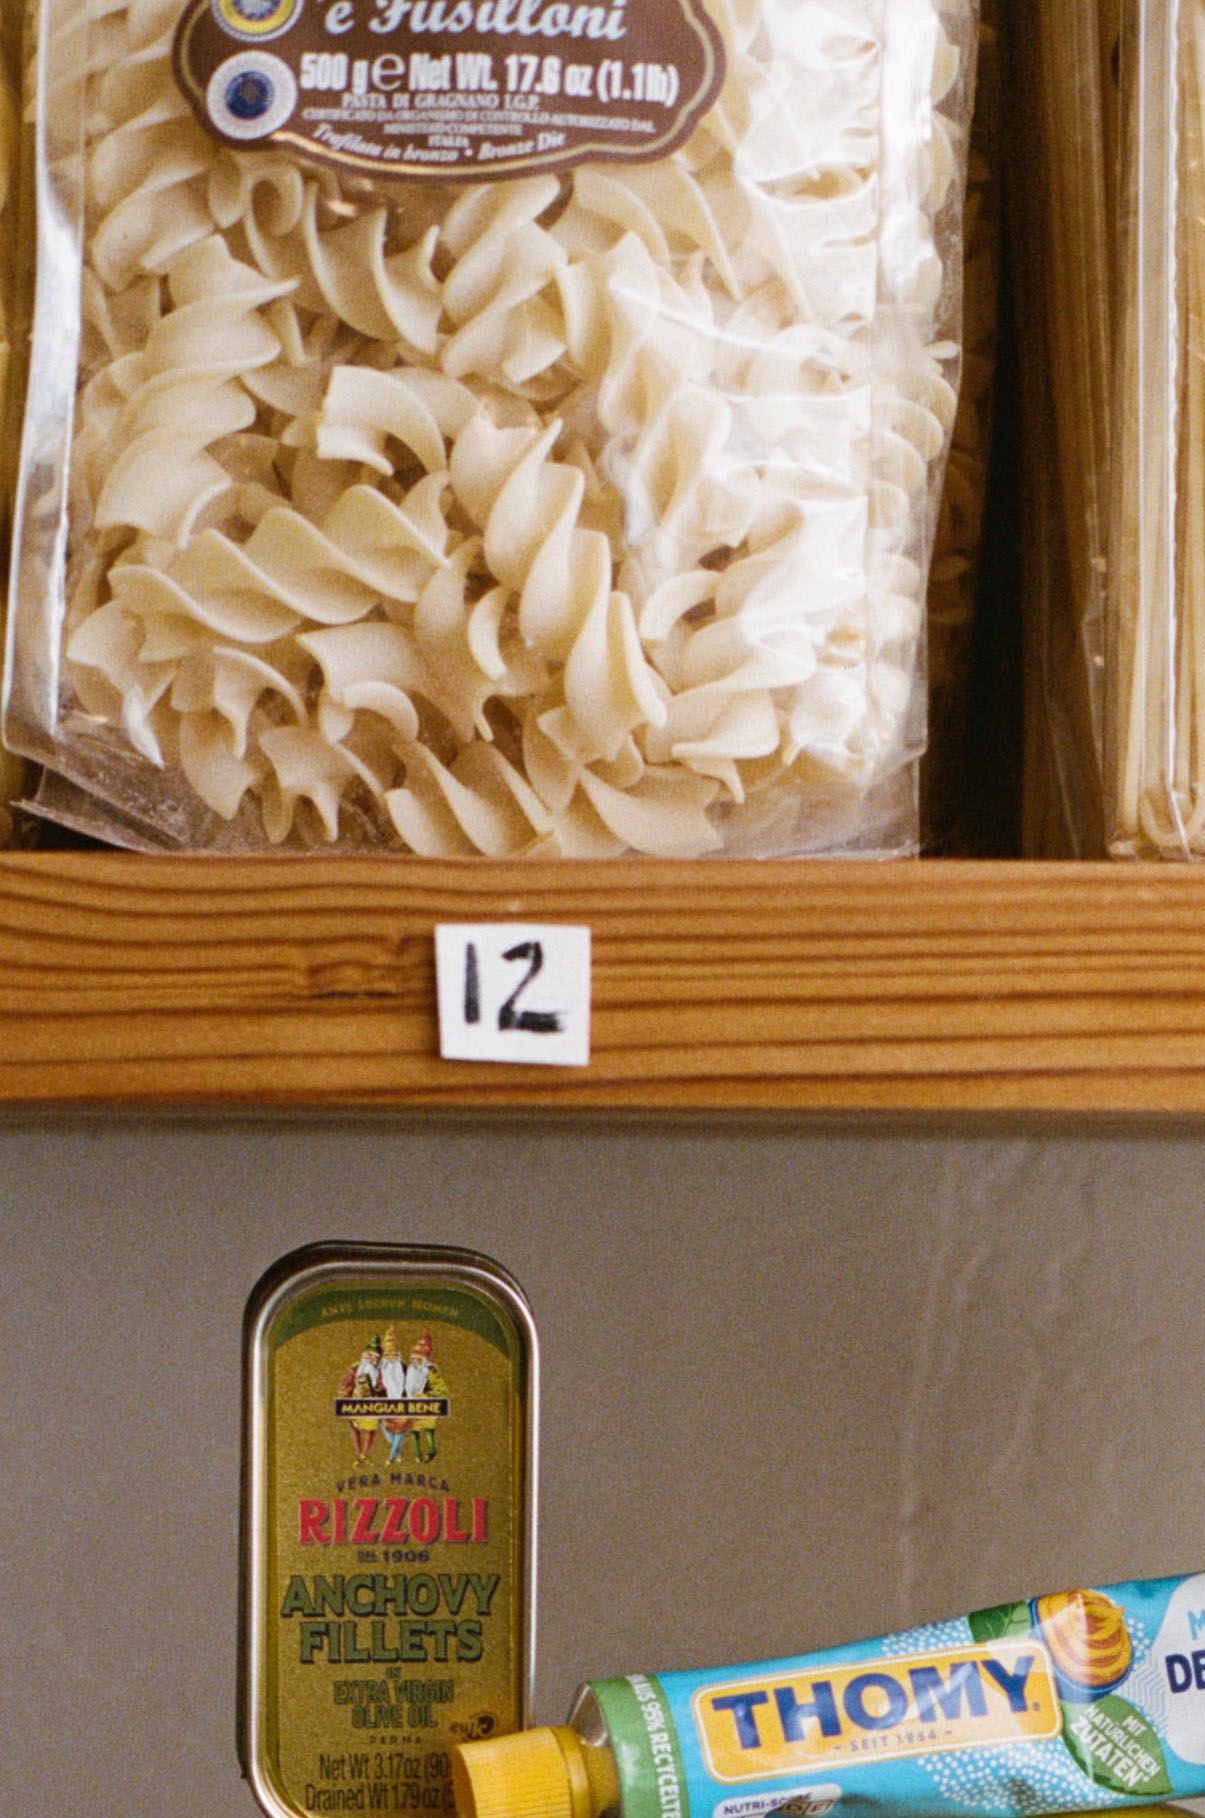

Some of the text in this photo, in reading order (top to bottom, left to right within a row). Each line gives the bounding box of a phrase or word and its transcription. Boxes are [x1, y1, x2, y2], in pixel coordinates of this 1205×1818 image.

[301, 53, 348, 90] 500
[352, 60, 368, 95] g
[409, 53, 451, 90] Net
[455, 53, 498, 91] Wt.
[505, 54, 561, 95] 17.6
[564, 64, 594, 97] oz
[597, 59, 680, 108] (1.1lb)
[464, 941, 566, 1033] 12
[341, 1402, 441, 1414] MANGIAR BENE
[336, 1472, 450, 1492] VERA MARCA
[297, 1496, 489, 1545] RIZZOLI
[280, 1573, 501, 1618] ANCHOVY
[300, 1618, 484, 1664] FILLETS
[333, 1679, 455, 1705] EXTRA VIRGIN
[712, 1655, 1035, 1751] THOMY
[352, 1705, 404, 1729] OLIVE
[407, 1704, 439, 1729] OIL
[1122, 1715, 1148, 1736] MIT
[319, 1755, 347, 1781] Net
[305, 1783, 365, 1811] Drained
